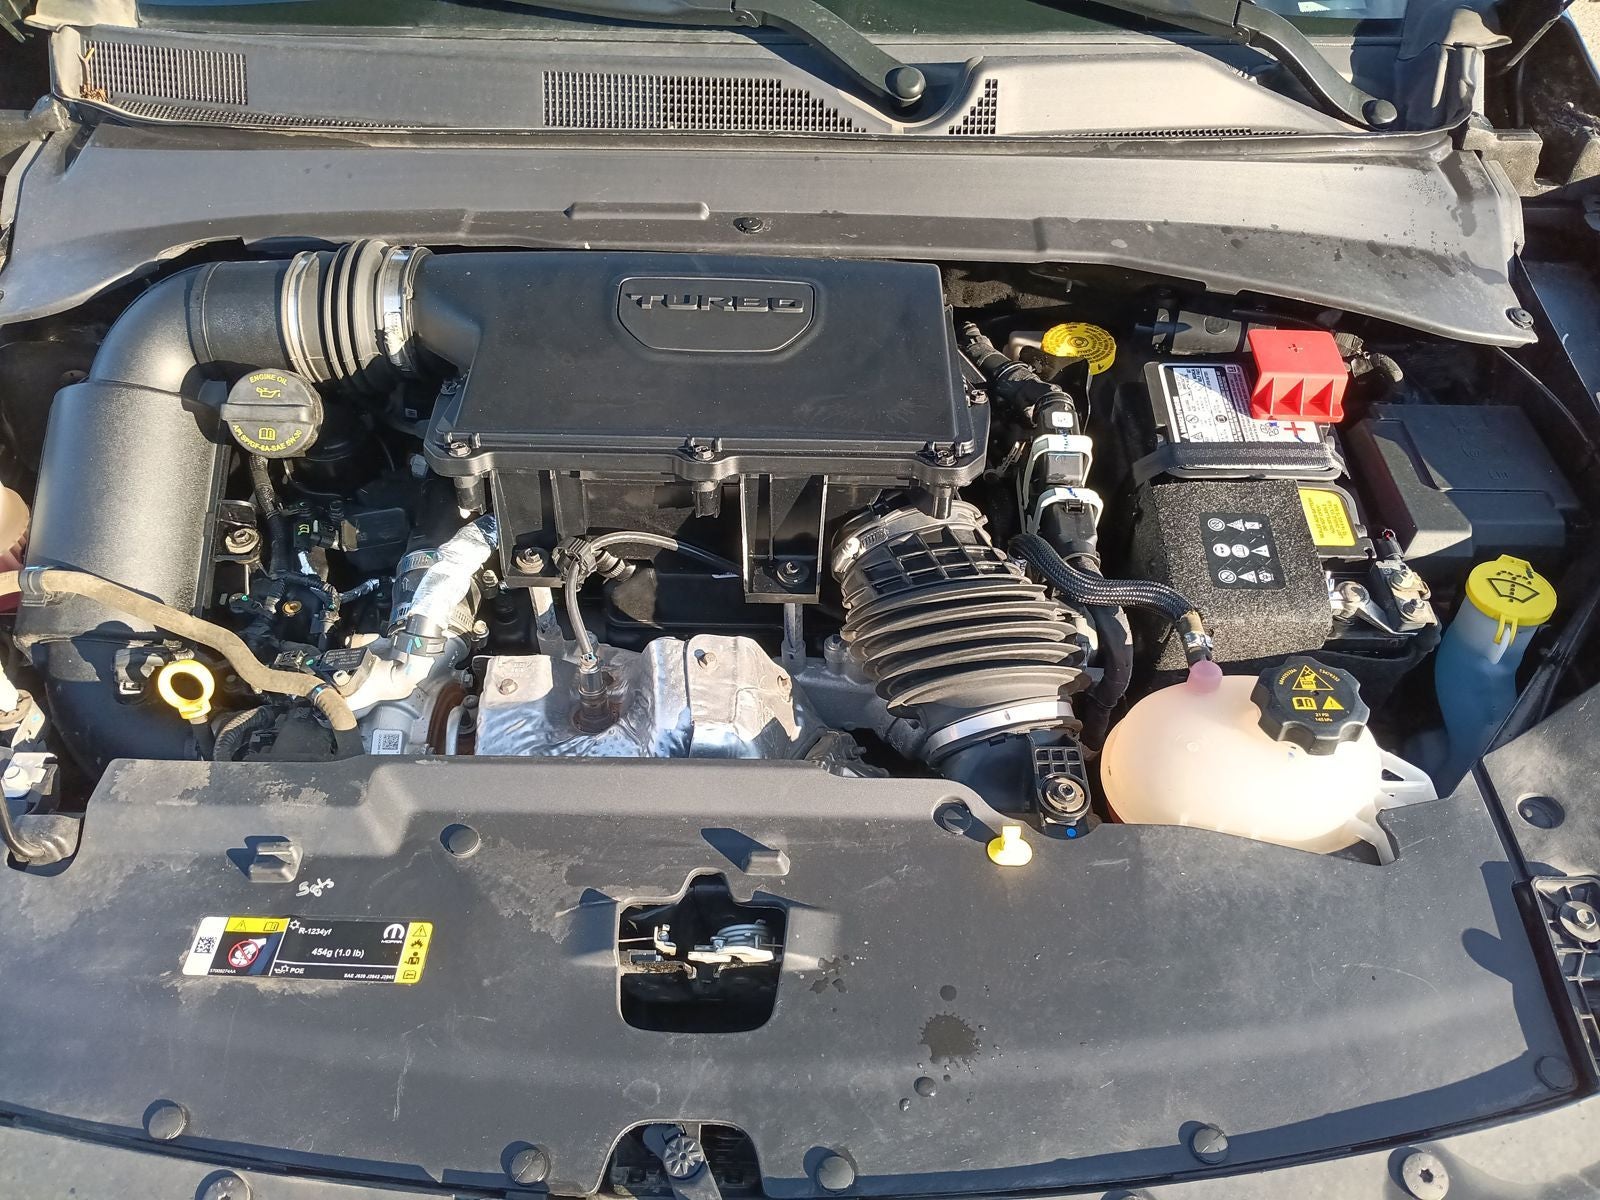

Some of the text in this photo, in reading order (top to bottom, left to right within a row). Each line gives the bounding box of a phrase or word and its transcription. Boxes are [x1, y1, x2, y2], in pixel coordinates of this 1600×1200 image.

[625, 293, 804, 313] TURBO
[249, 373, 288, 386] ENGINE OIL
[233, 424, 244, 437] API
[298, 927, 332, 937] R-1234yf
[311, 948, 365, 959] 454g (1.0 lb)
